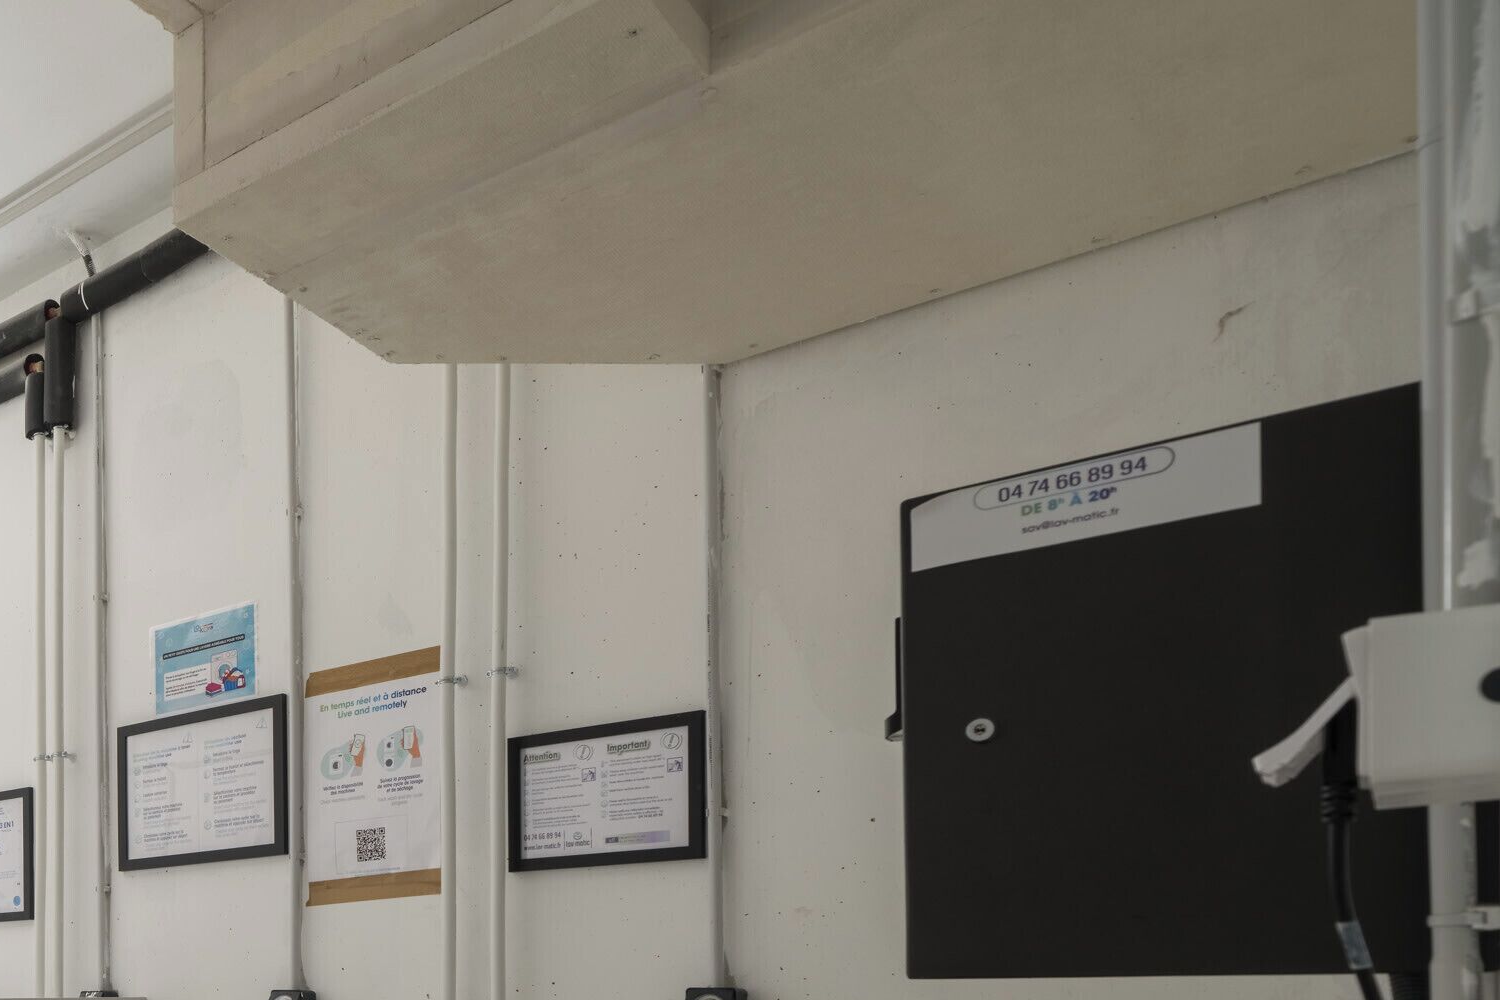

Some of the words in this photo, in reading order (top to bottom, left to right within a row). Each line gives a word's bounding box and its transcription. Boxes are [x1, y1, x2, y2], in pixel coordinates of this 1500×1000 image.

[998, 484, 1022, 502] 04
[1028, 478, 1049, 496] 74
[1056, 471, 1081, 489] 66
[1087, 464, 1113, 483] 89
[1120, 456, 1147, 475] 94
[1021, 502, 1042, 516] DE
[1021, 507, 1119, 534] sav@lav-matic.fr
[320, 704, 329, 713] En
[330, 700, 354, 711] temps
[356, 695, 371, 706] réel
[373, 694, 381, 703] et
[383, 692, 389, 701] à
[390, 685, 427, 699] distance
[337, 710, 352, 719] Live
[354, 705, 370, 716] and
[372, 699, 408, 712] remotely
[607, 740, 648, 754] Important
[523, 752, 558, 763] Attention
